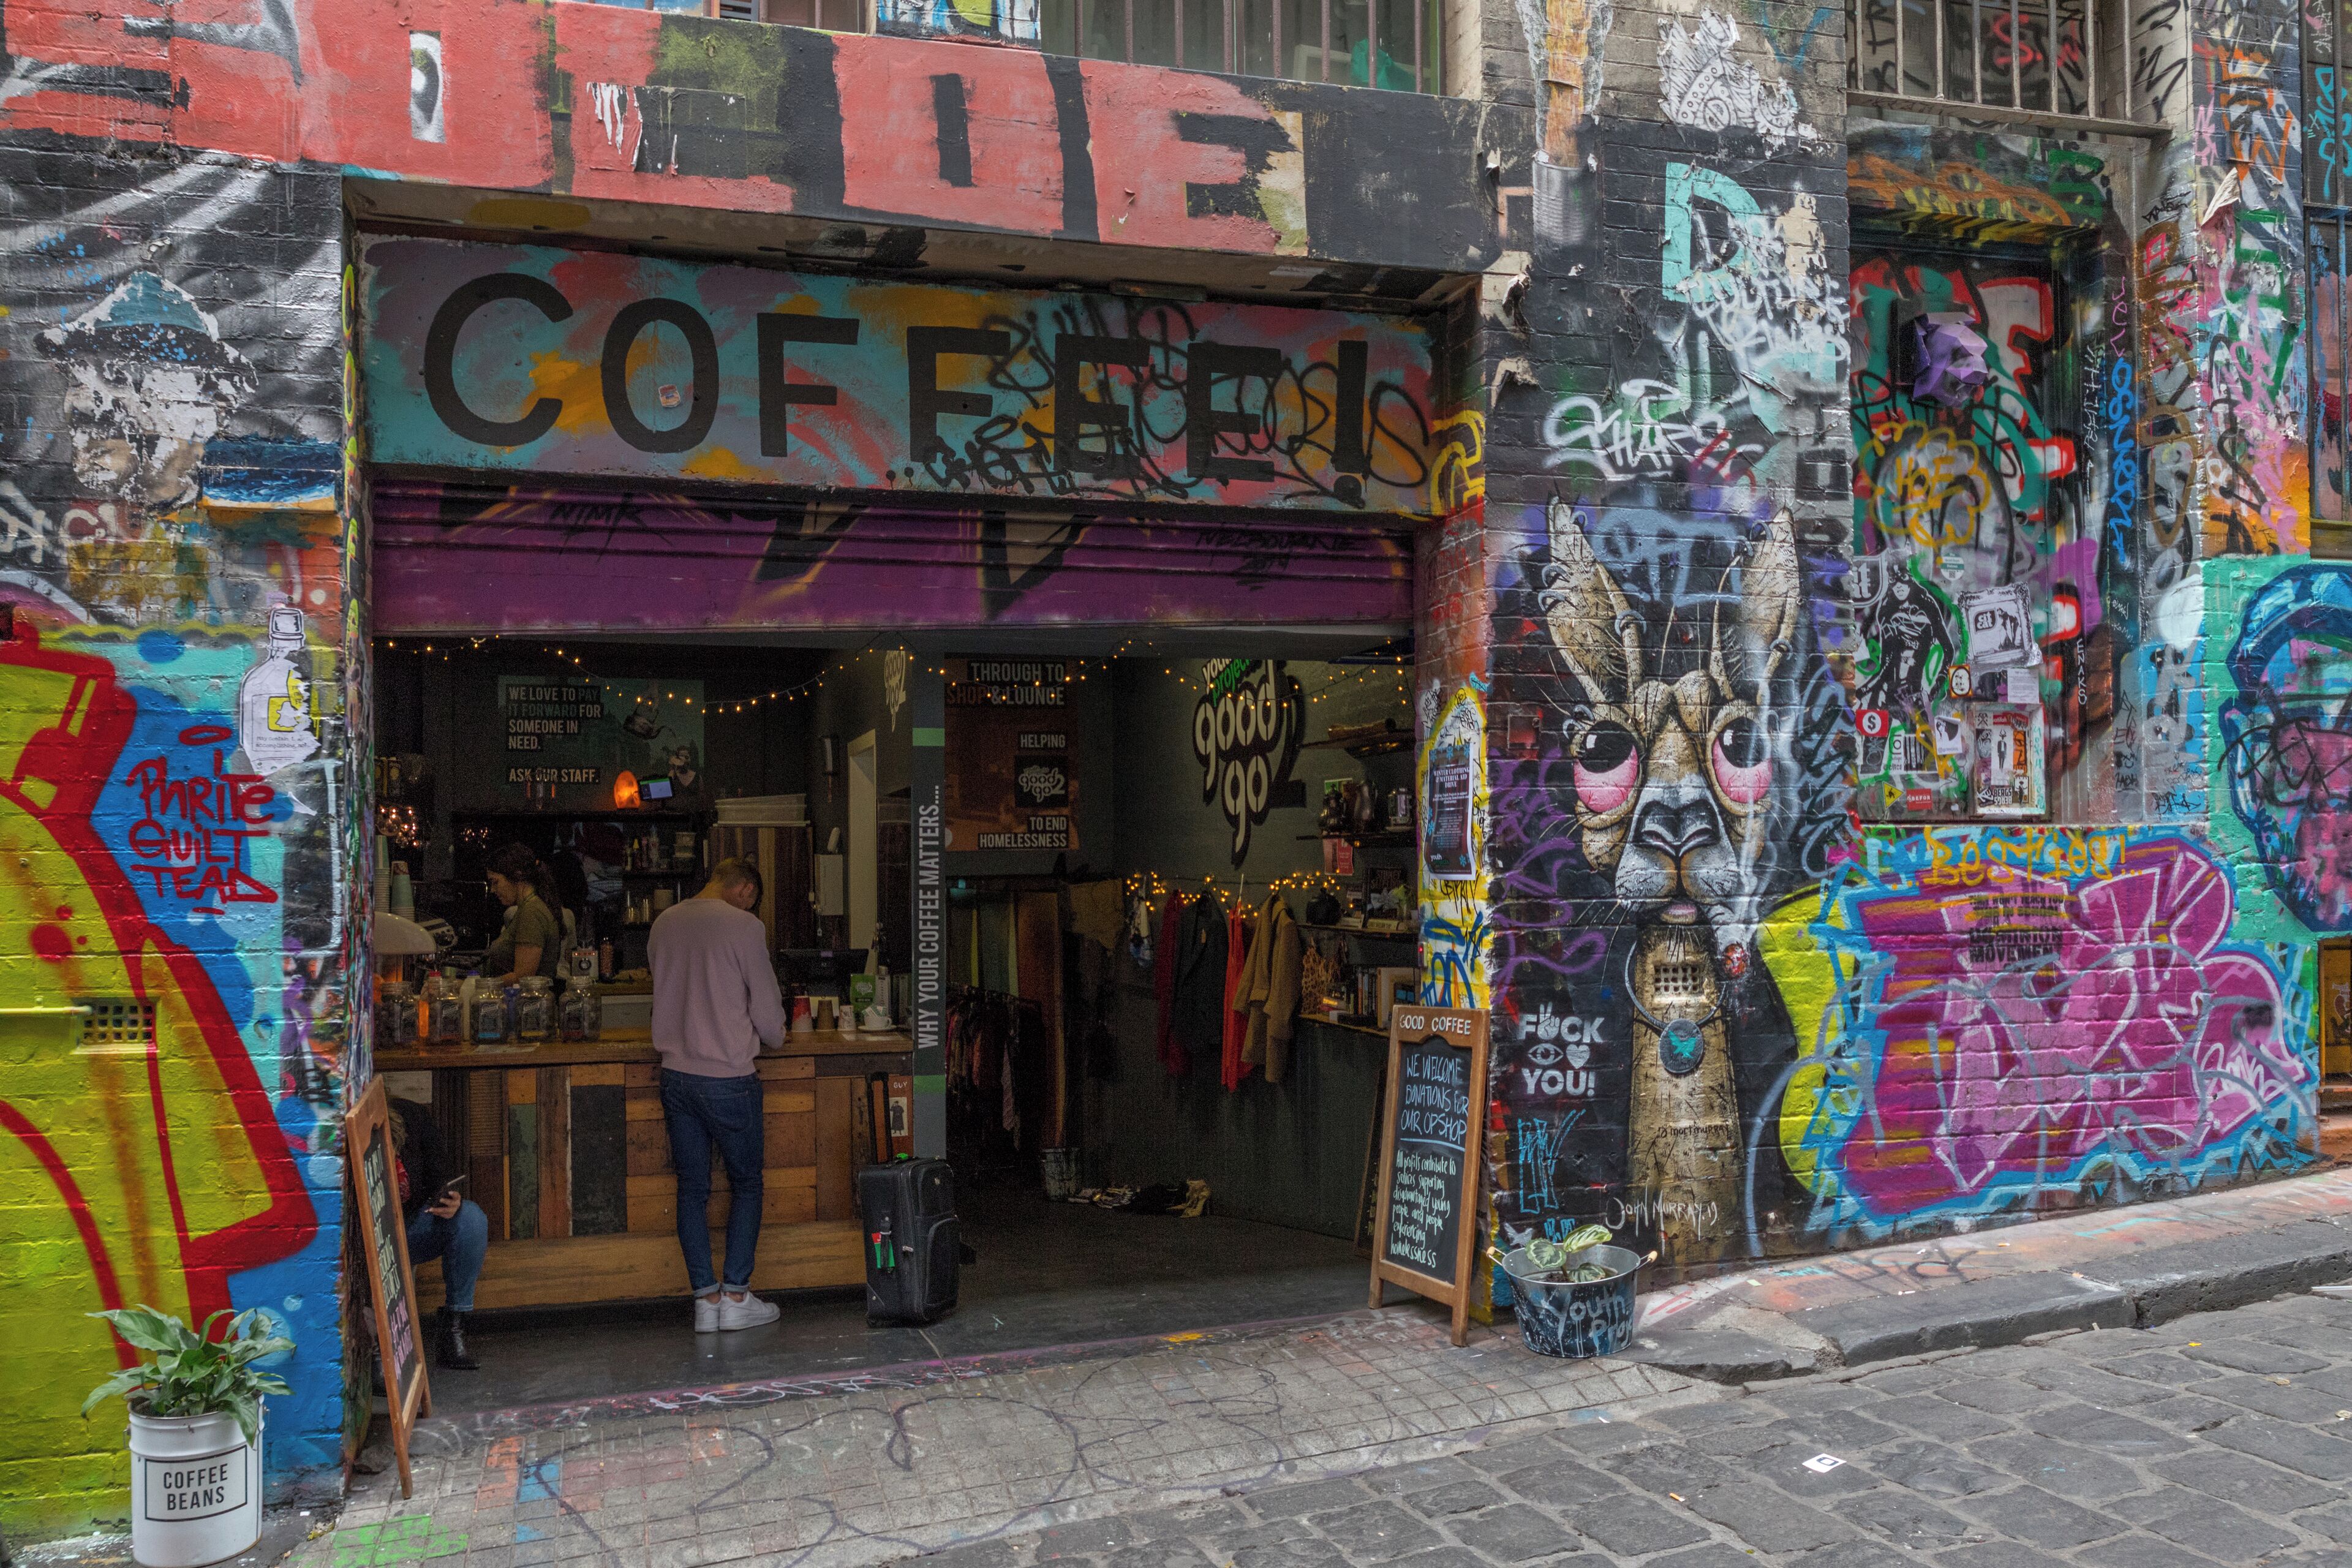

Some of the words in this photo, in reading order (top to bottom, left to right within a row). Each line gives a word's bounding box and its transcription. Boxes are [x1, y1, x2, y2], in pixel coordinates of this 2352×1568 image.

[423, 271, 1370, 500] COFFEE!
[1977, 619, 1993, 630] cat
[1978, 611, 1992, 623] cit
[971, 662, 1042, 682] THROUGH
[1046, 663, 1065, 682] TO
[508, 687, 526, 701] WE
[529, 687, 559, 701] LOVE
[560, 688, 576, 701] TO
[578, 688, 598, 701] PAY
[946, 686, 987, 704] SHOP
[991, 686, 1003, 705] &
[1006, 687, 1065, 706] LOUNGE
[521, 703, 577, 717] FORWARD
[579, 704, 601, 718] FOR
[508, 719, 564, 733] SOMEONE
[566, 720, 579, 733] IN
[1196, 659, 1276, 791] good
[508, 735, 541, 749] NEED.
[1020, 734, 1066, 748] HELPING
[508, 768, 533, 782] ASK
[535, 768, 558, 782] OUR
[560, 769, 600, 783] STAFF.
[1019, 766, 1060, 794] good
[1031, 785, 1054, 803] go
[1224, 755, 1268, 853] go
[1994, 788, 2012, 797] BERGS
[918, 785, 940, 886] MATTERS....
[1030, 817, 1044, 831] TO
[1046, 817, 1067, 831] END
[979, 833, 1068, 848] HOMELESSNESS
[918, 889, 940, 952] COFFEE
[918, 957, 940, 1004] YOUR
[918, 1008, 940, 1049] WHY
[1399, 1014, 1425, 1030] GOOD
[1431, 1017, 1472, 1035] COFFEE
[1406, 1054, 1420, 1079] WE
[1422, 1054, 1463, 1084] WELCOME
[1521, 1068, 1596, 1097] YOU!
[1405, 1085, 1452, 1113] DONATIONS
[1400, 1110, 1422, 1136] OUR
[1424, 1112, 1467, 1145] OPSHOP
[1403, 1152, 1421, 1172] profits
[1421, 1155, 1448, 1174] contribute
[1449, 1159, 1457, 1175] to
[1418, 1174, 1445, 1196] supporting
[1392, 1202, 1409, 1223] people
[1411, 1208, 1424, 1225] and
[1425, 1213, 1444, 1231] people
[1431, 1194, 1451, 1218] young
[1392, 1219, 1427, 1243] experiencing
[1390, 1232, 1437, 1268] homelessness
[1541, 1284, 1626, 1338] Youth
[164, 1463, 228, 1489] COFFEE
[167, 1486, 225, 1510] BEANS
